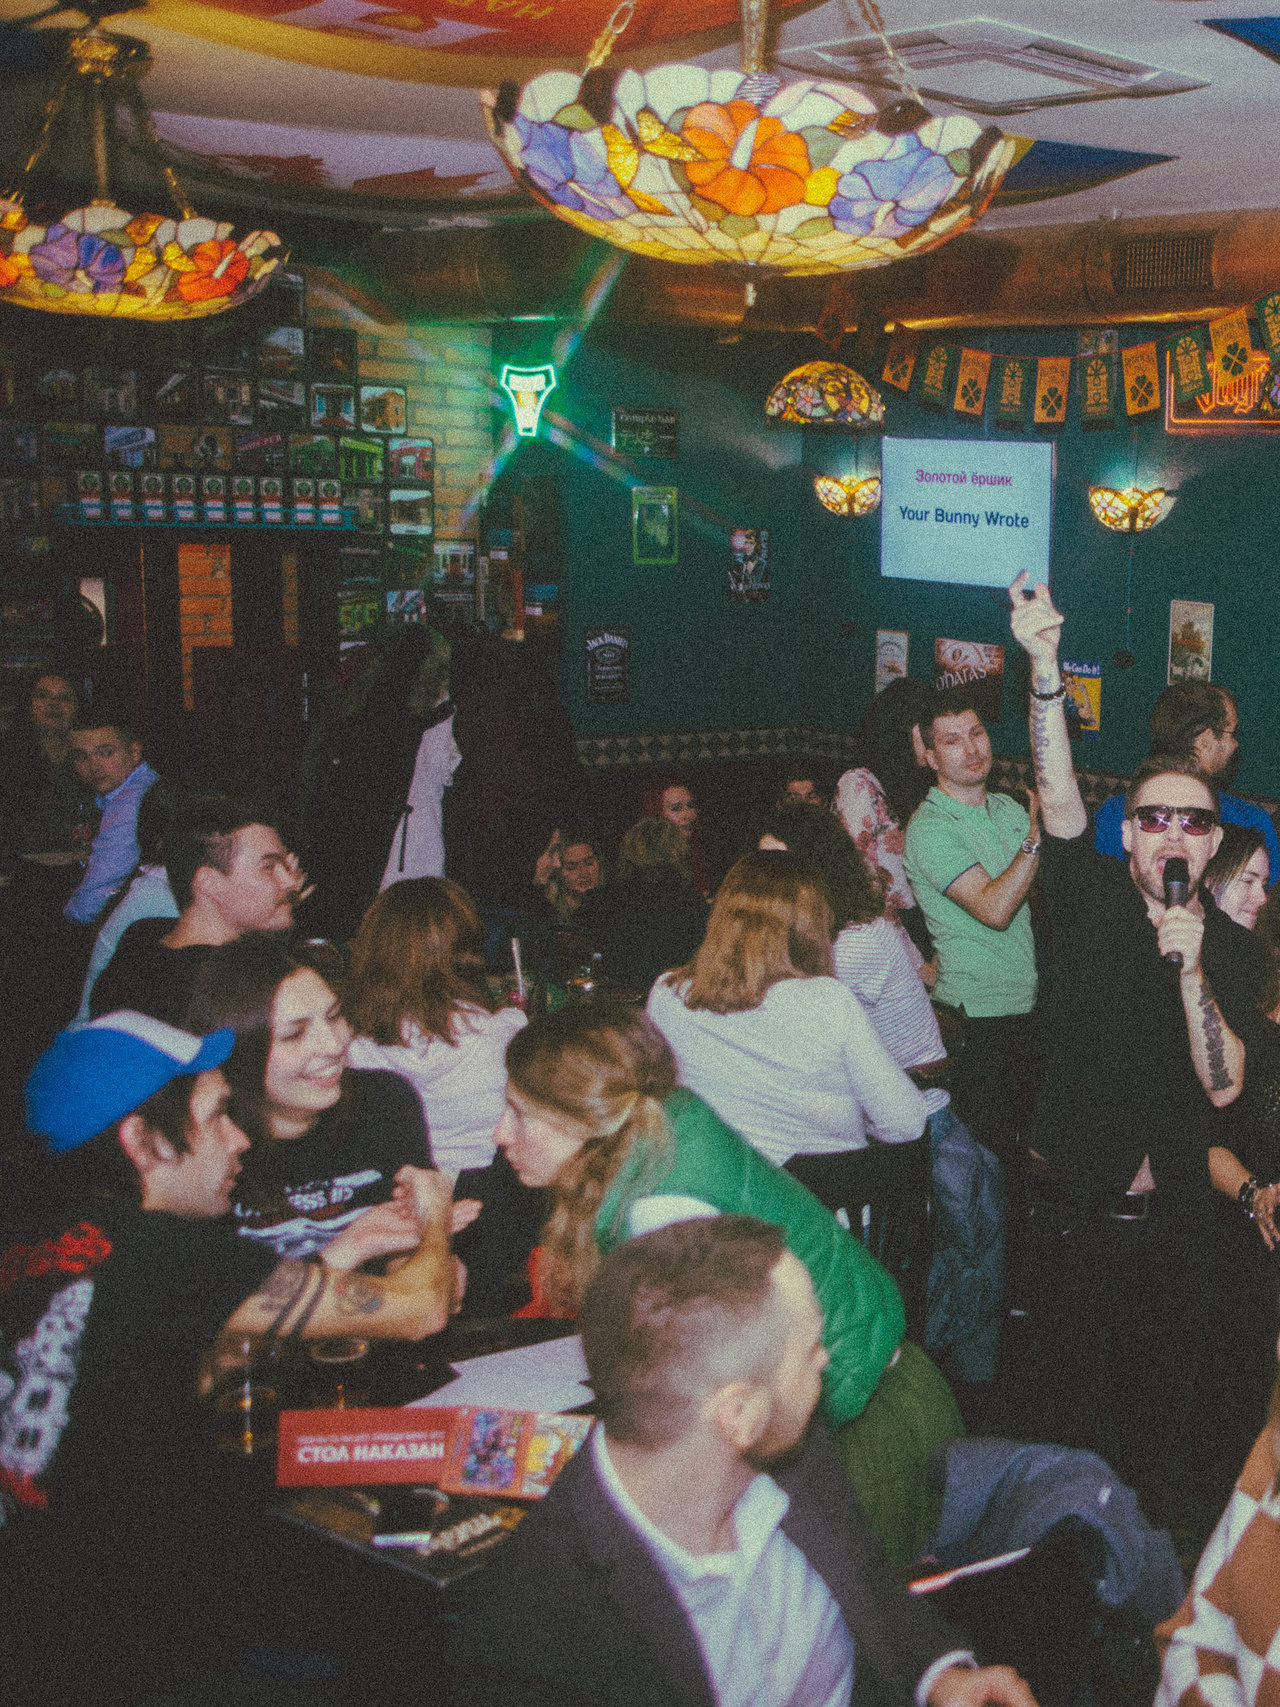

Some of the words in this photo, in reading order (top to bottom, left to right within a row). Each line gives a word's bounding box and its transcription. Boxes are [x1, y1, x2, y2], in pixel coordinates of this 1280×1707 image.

[915, 469, 967, 484] Золотой
[971, 472, 1012, 487] ёршик
[899, 506, 930, 521] Your
[935, 508, 979, 528] Bunny
[985, 511, 1029, 528] Wrote
[1072, 663, 1082, 672] Can
[1083, 665, 1091, 674] Do
[297, 1446, 350, 1463] СТОЛ
[354, 1442, 445, 1461] НАКАЗАН
